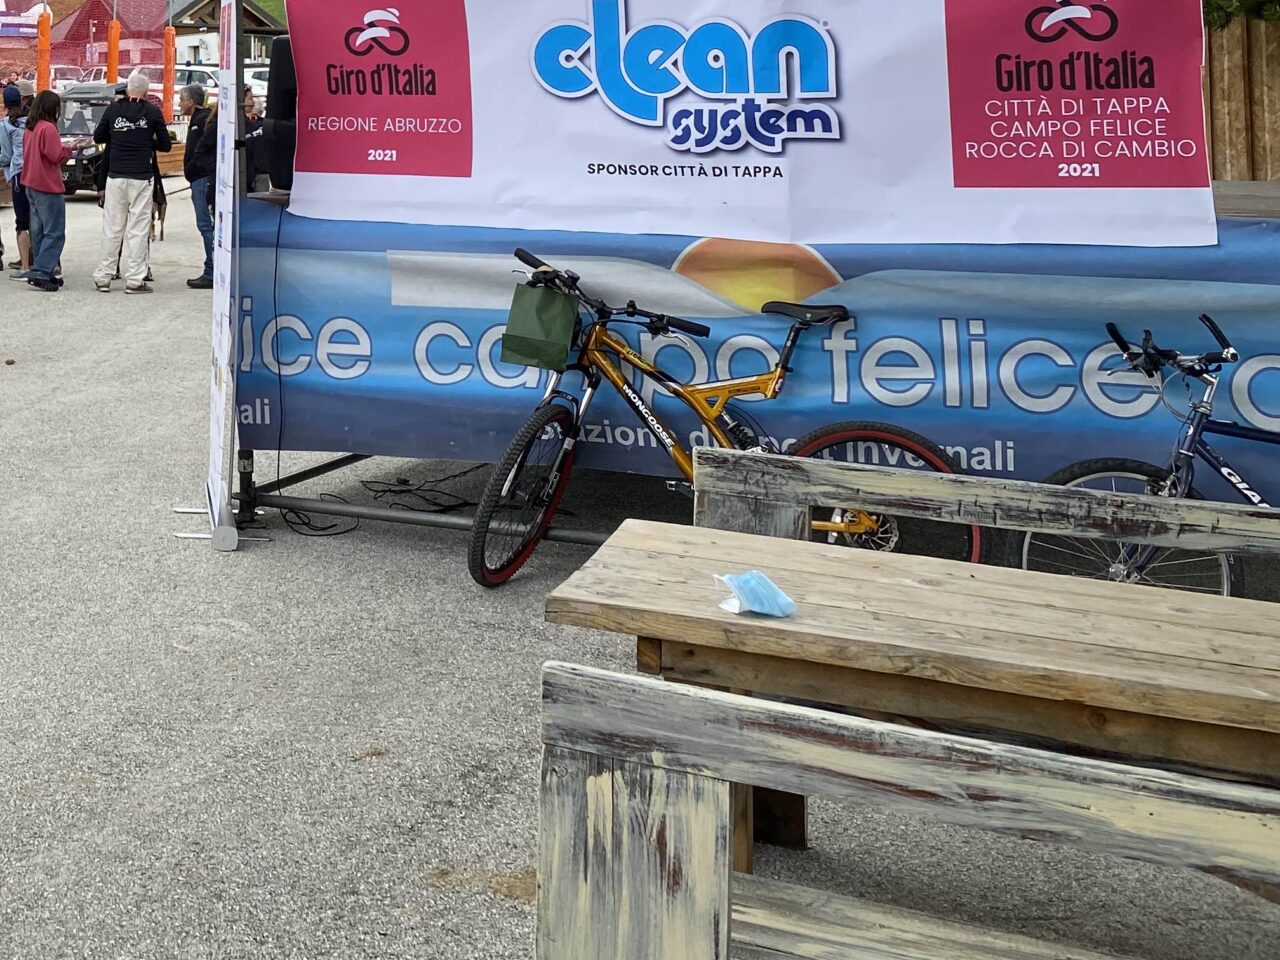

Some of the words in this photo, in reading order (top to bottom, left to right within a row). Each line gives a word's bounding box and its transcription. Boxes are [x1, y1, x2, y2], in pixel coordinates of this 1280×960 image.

[326, 63, 367, 96] Giro
[370, 62, 437, 96] d'Italia
[994, 52, 1054, 93] Giro
[1058, 49, 1156, 91] d'Italia
[984, 95, 1053, 117] CITTÀ
[1061, 99, 1085, 116] DI
[1091, 96, 1171, 115] TAPPA
[307, 116, 379, 132] REGIONE
[383, 117, 463, 134] ABRUZZO
[670, 98, 832, 148] system
[990, 119, 1081, 138] CAMPO
[1089, 118, 1167, 137] FELICE
[367, 149, 398, 162] 2021
[965, 141, 1054, 159] ROCCA
[1062, 141, 1086, 158] DI
[1093, 139, 1198, 158] CAMBIO
[586, 162, 660, 177] SPONSOR
[661, 162, 707, 178] CITTÀ
[712, 165, 729, 178] DI
[732, 165, 784, 179] TAPPA
[1057, 163, 1101, 177] 2021
[240, 296, 372, 380] ice
[414, 319, 783, 404] capo
[822, 315, 1163, 420] felice
[235, 398, 271, 425] ali
[622, 383, 675, 448] MONGOOSE
